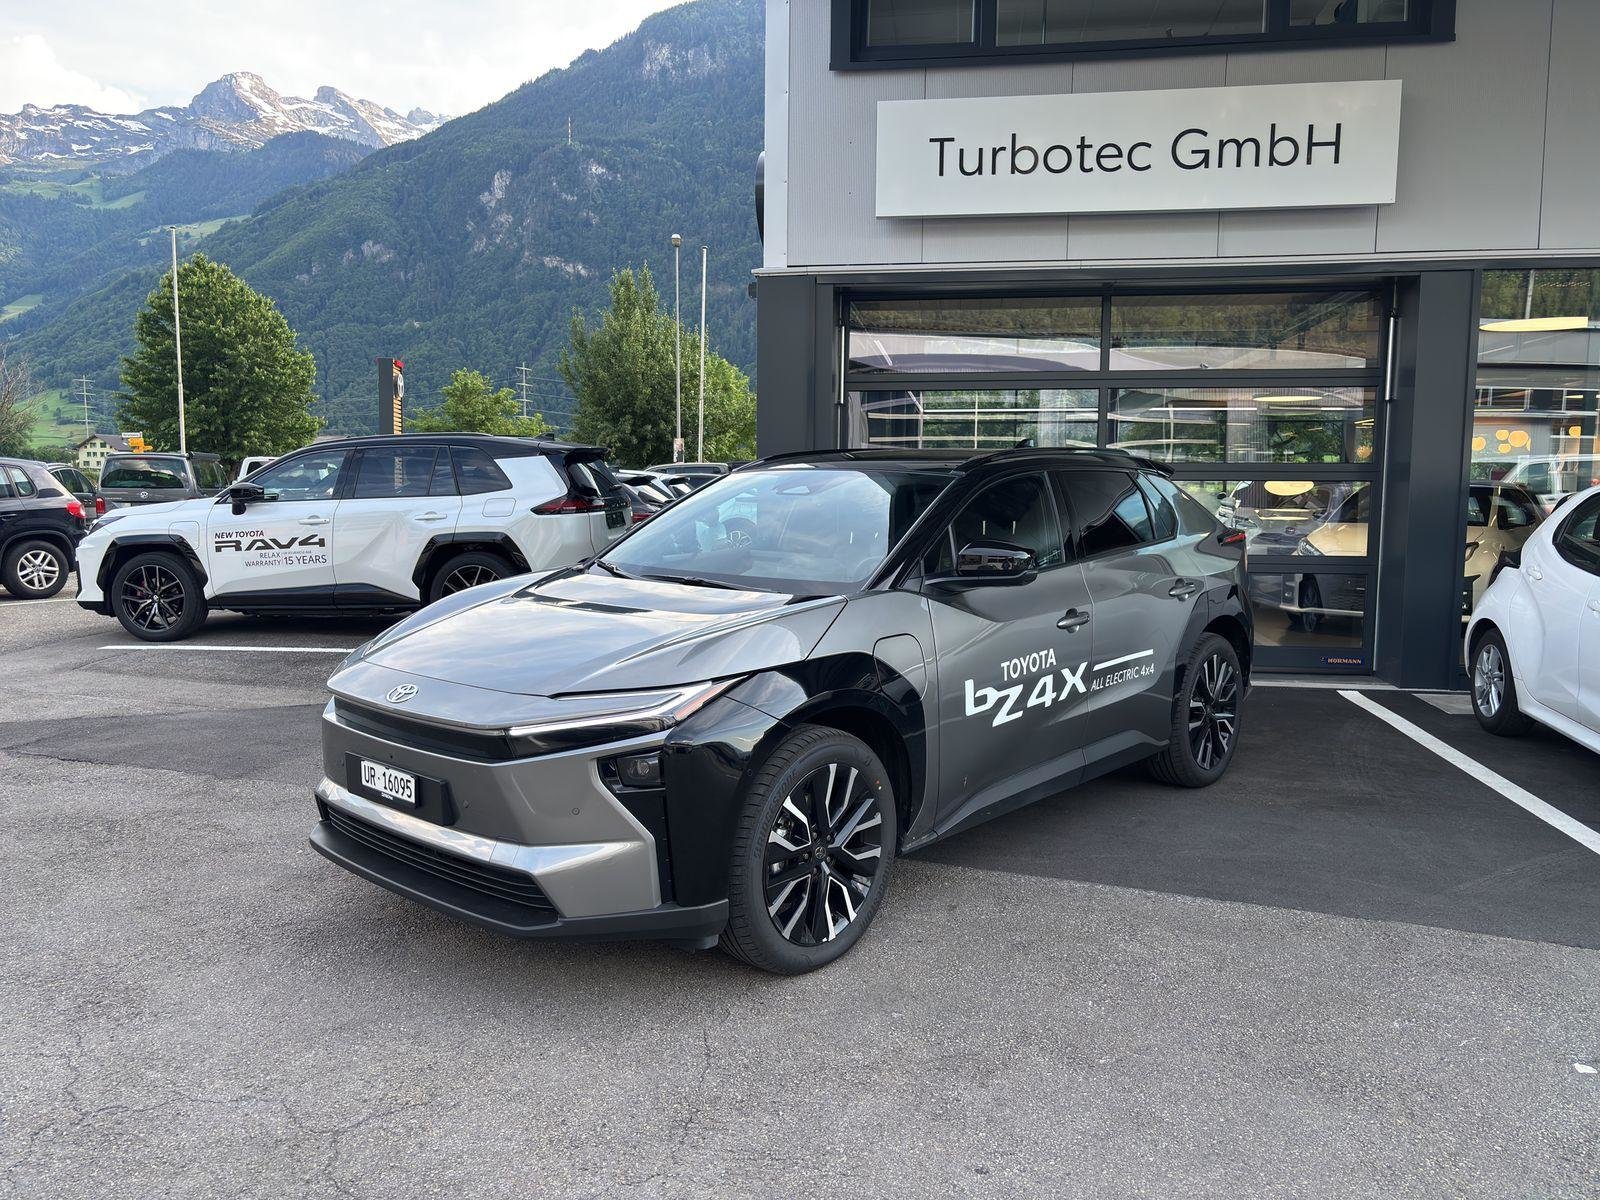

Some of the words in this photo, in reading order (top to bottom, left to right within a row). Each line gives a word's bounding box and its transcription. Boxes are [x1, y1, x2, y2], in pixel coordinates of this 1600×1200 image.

[929, 133, 1152, 177] Turbotec
[1171, 122, 1343, 170] GmbH
[214, 534, 326, 553] RAV4
[235, 530, 265, 538] TOYOTA
[284, 556, 294, 566] 15
[297, 554, 327, 565] YEARS
[1001, 648, 1057, 681] TOYOTA
[1090, 678, 1105, 692] ALL
[1105, 666, 1139, 687] ELECTRIC
[1140, 662, 1155, 678] 4x4
